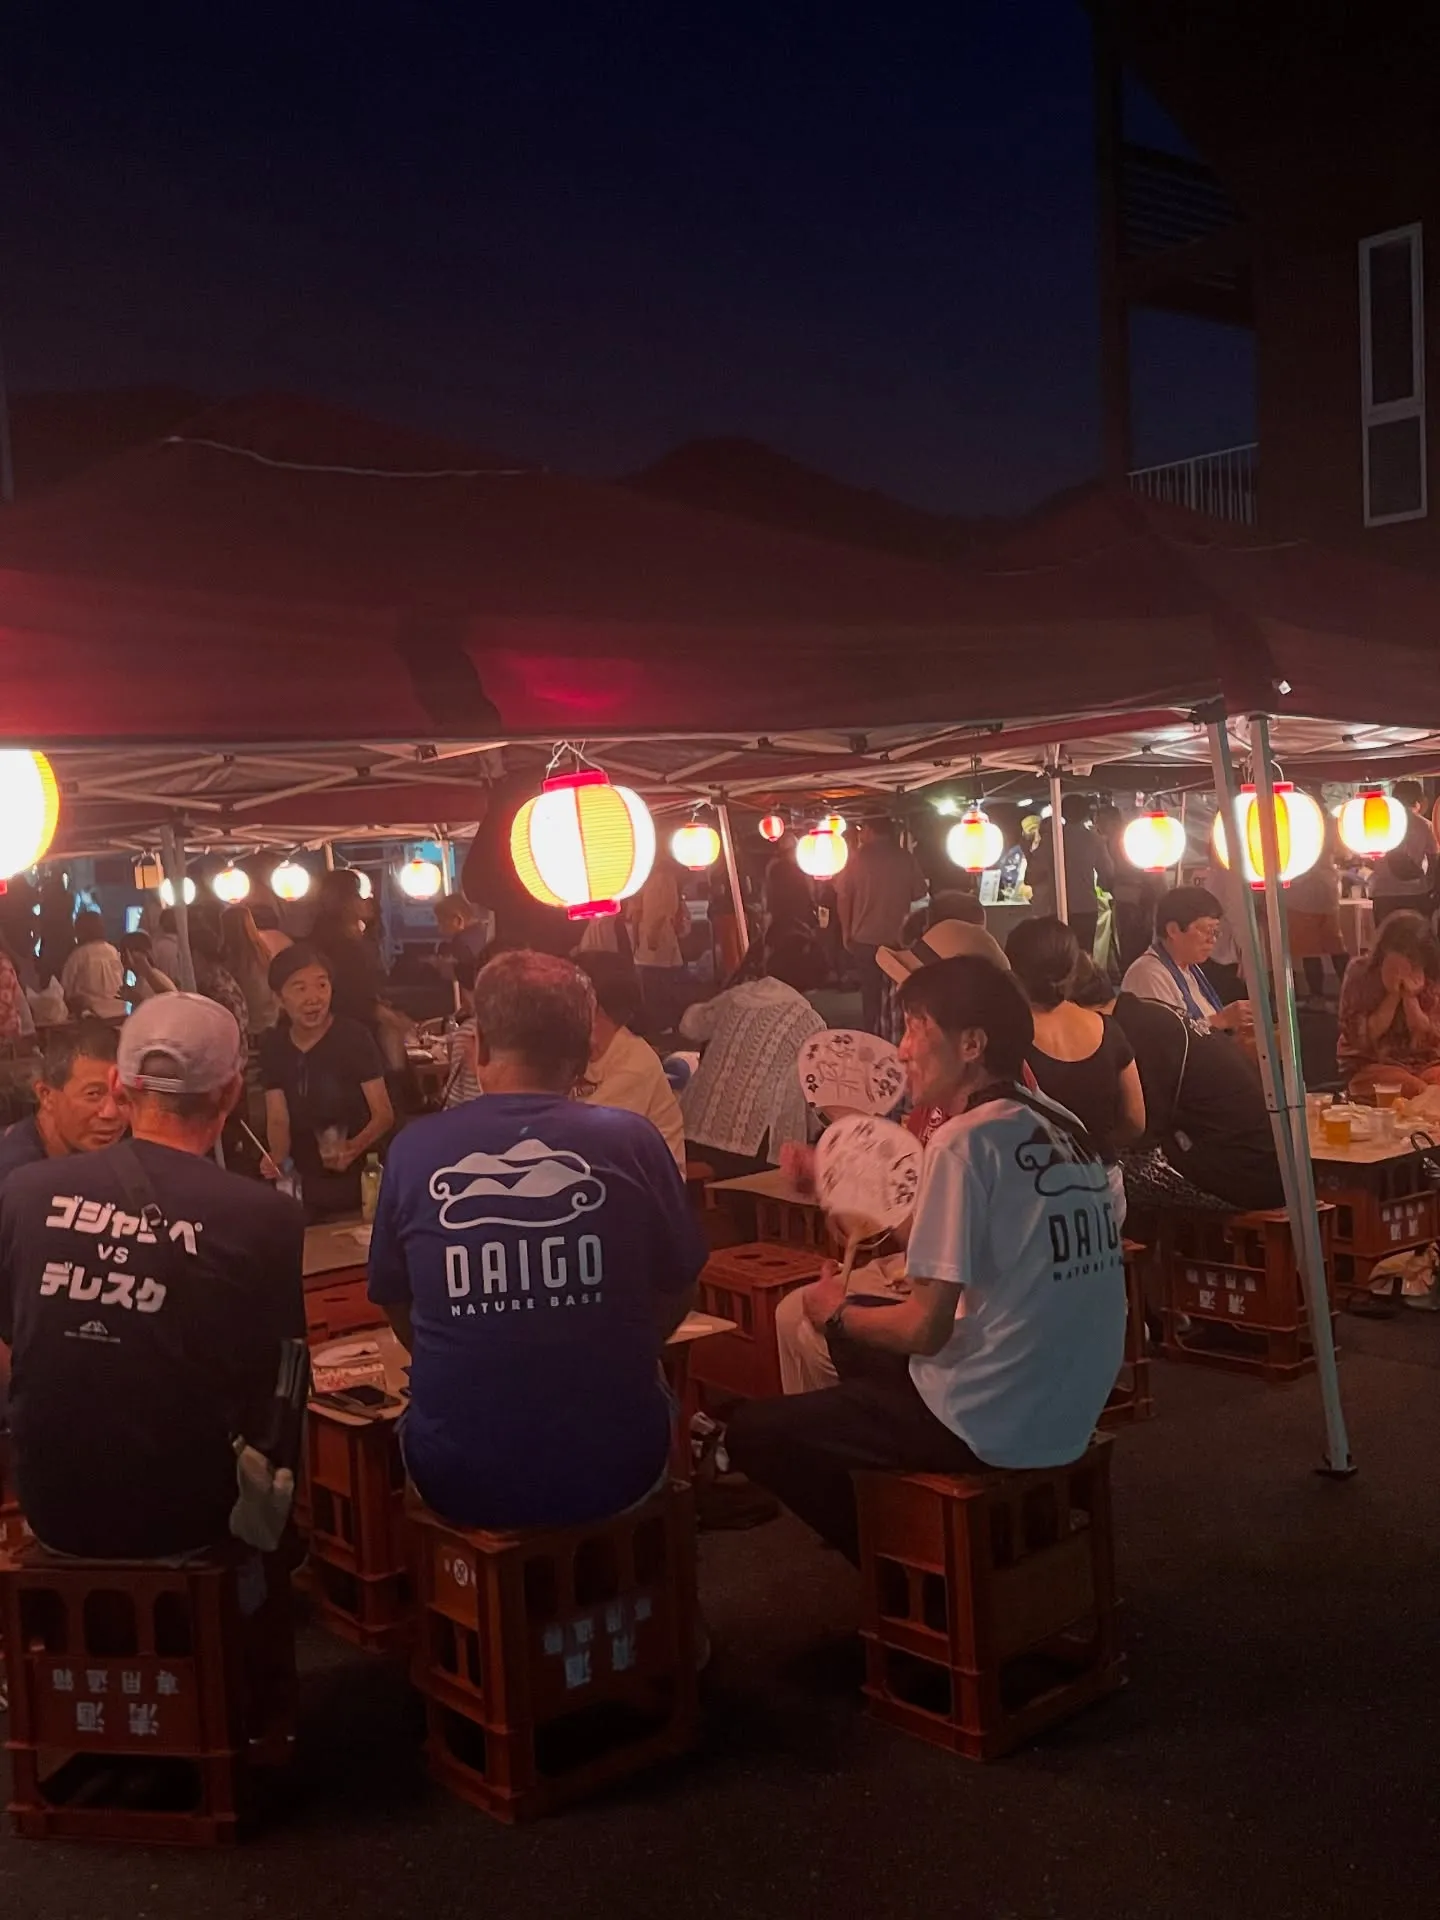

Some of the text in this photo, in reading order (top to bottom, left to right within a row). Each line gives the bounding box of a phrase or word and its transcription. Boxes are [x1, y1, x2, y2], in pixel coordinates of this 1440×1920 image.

[445, 1233, 603, 1298] DAIGO
[450, 1297, 536, 1318] NATURE
[76, 1700, 160, 1737] 清酒
